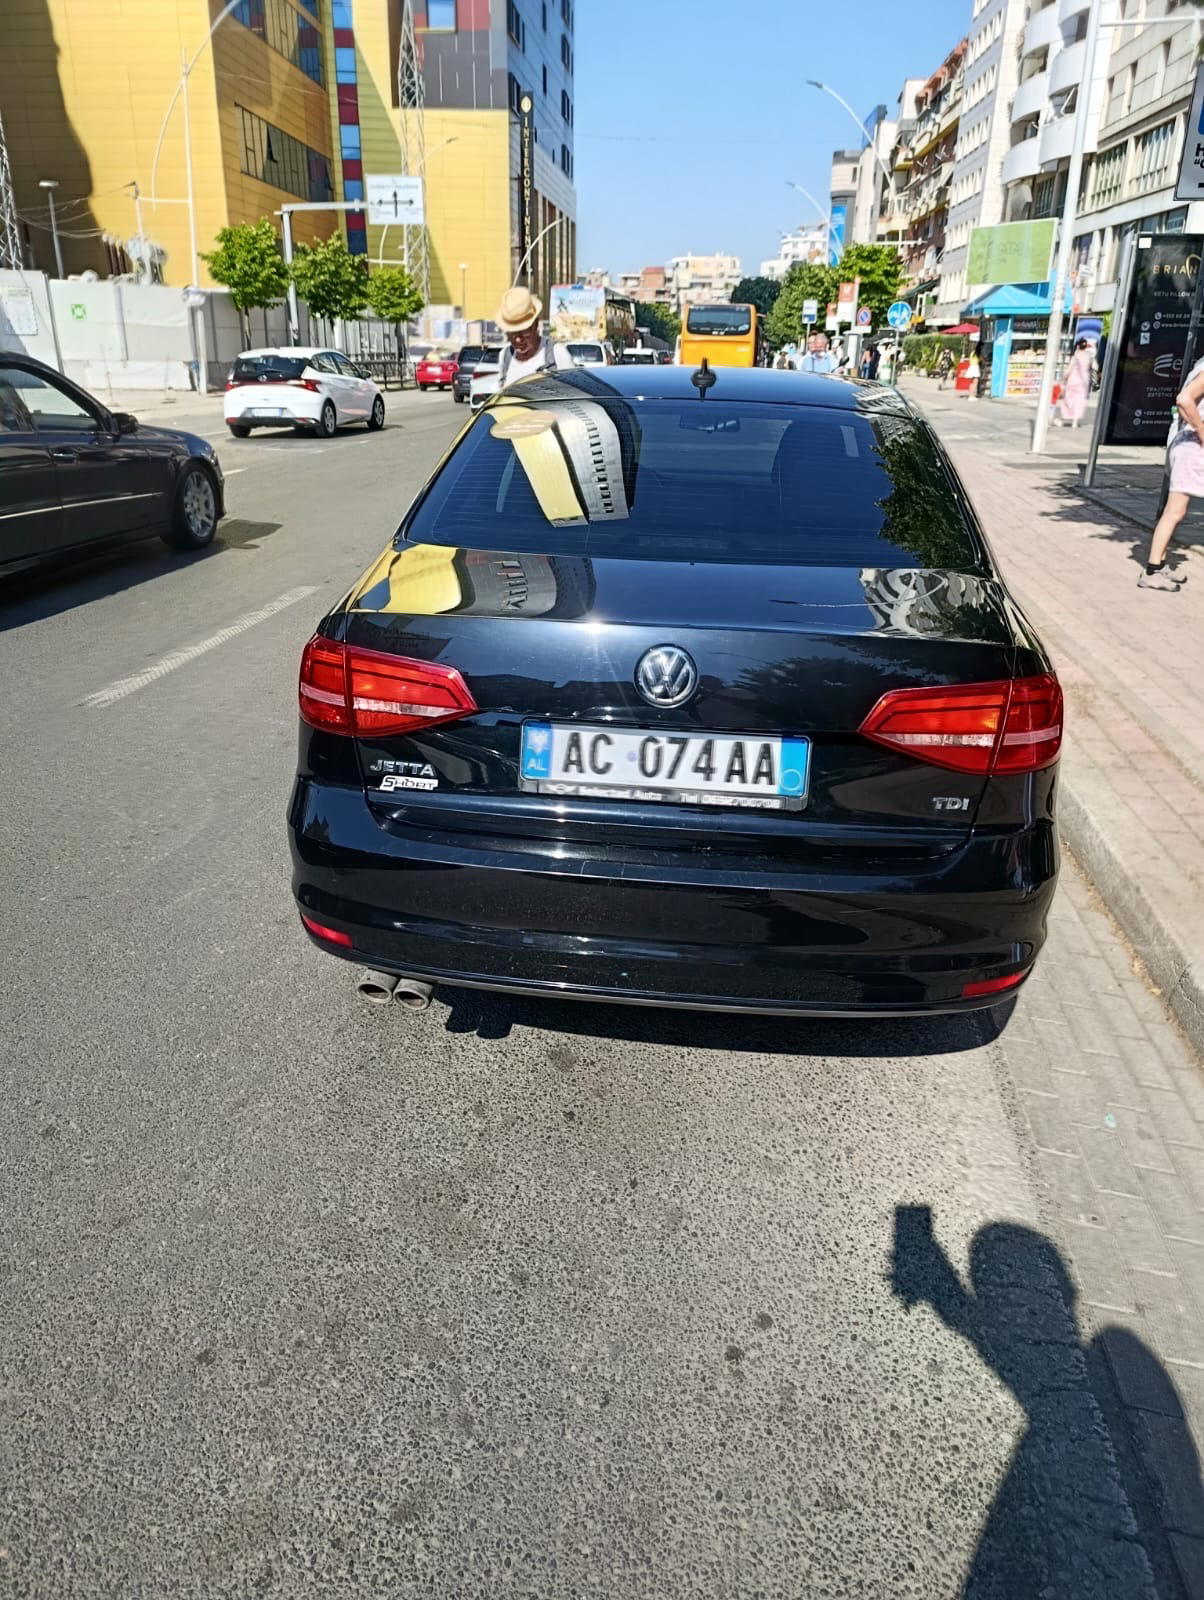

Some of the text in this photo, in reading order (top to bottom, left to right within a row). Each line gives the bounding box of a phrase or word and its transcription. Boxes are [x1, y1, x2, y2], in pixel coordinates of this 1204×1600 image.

[523, 116, 532, 273] INTERCONTINENAL
[561, 731, 615, 775] AC
[369, 759, 435, 777] JETTA
[526, 757, 547, 772] AL
[932, 797, 970, 811] TDI
